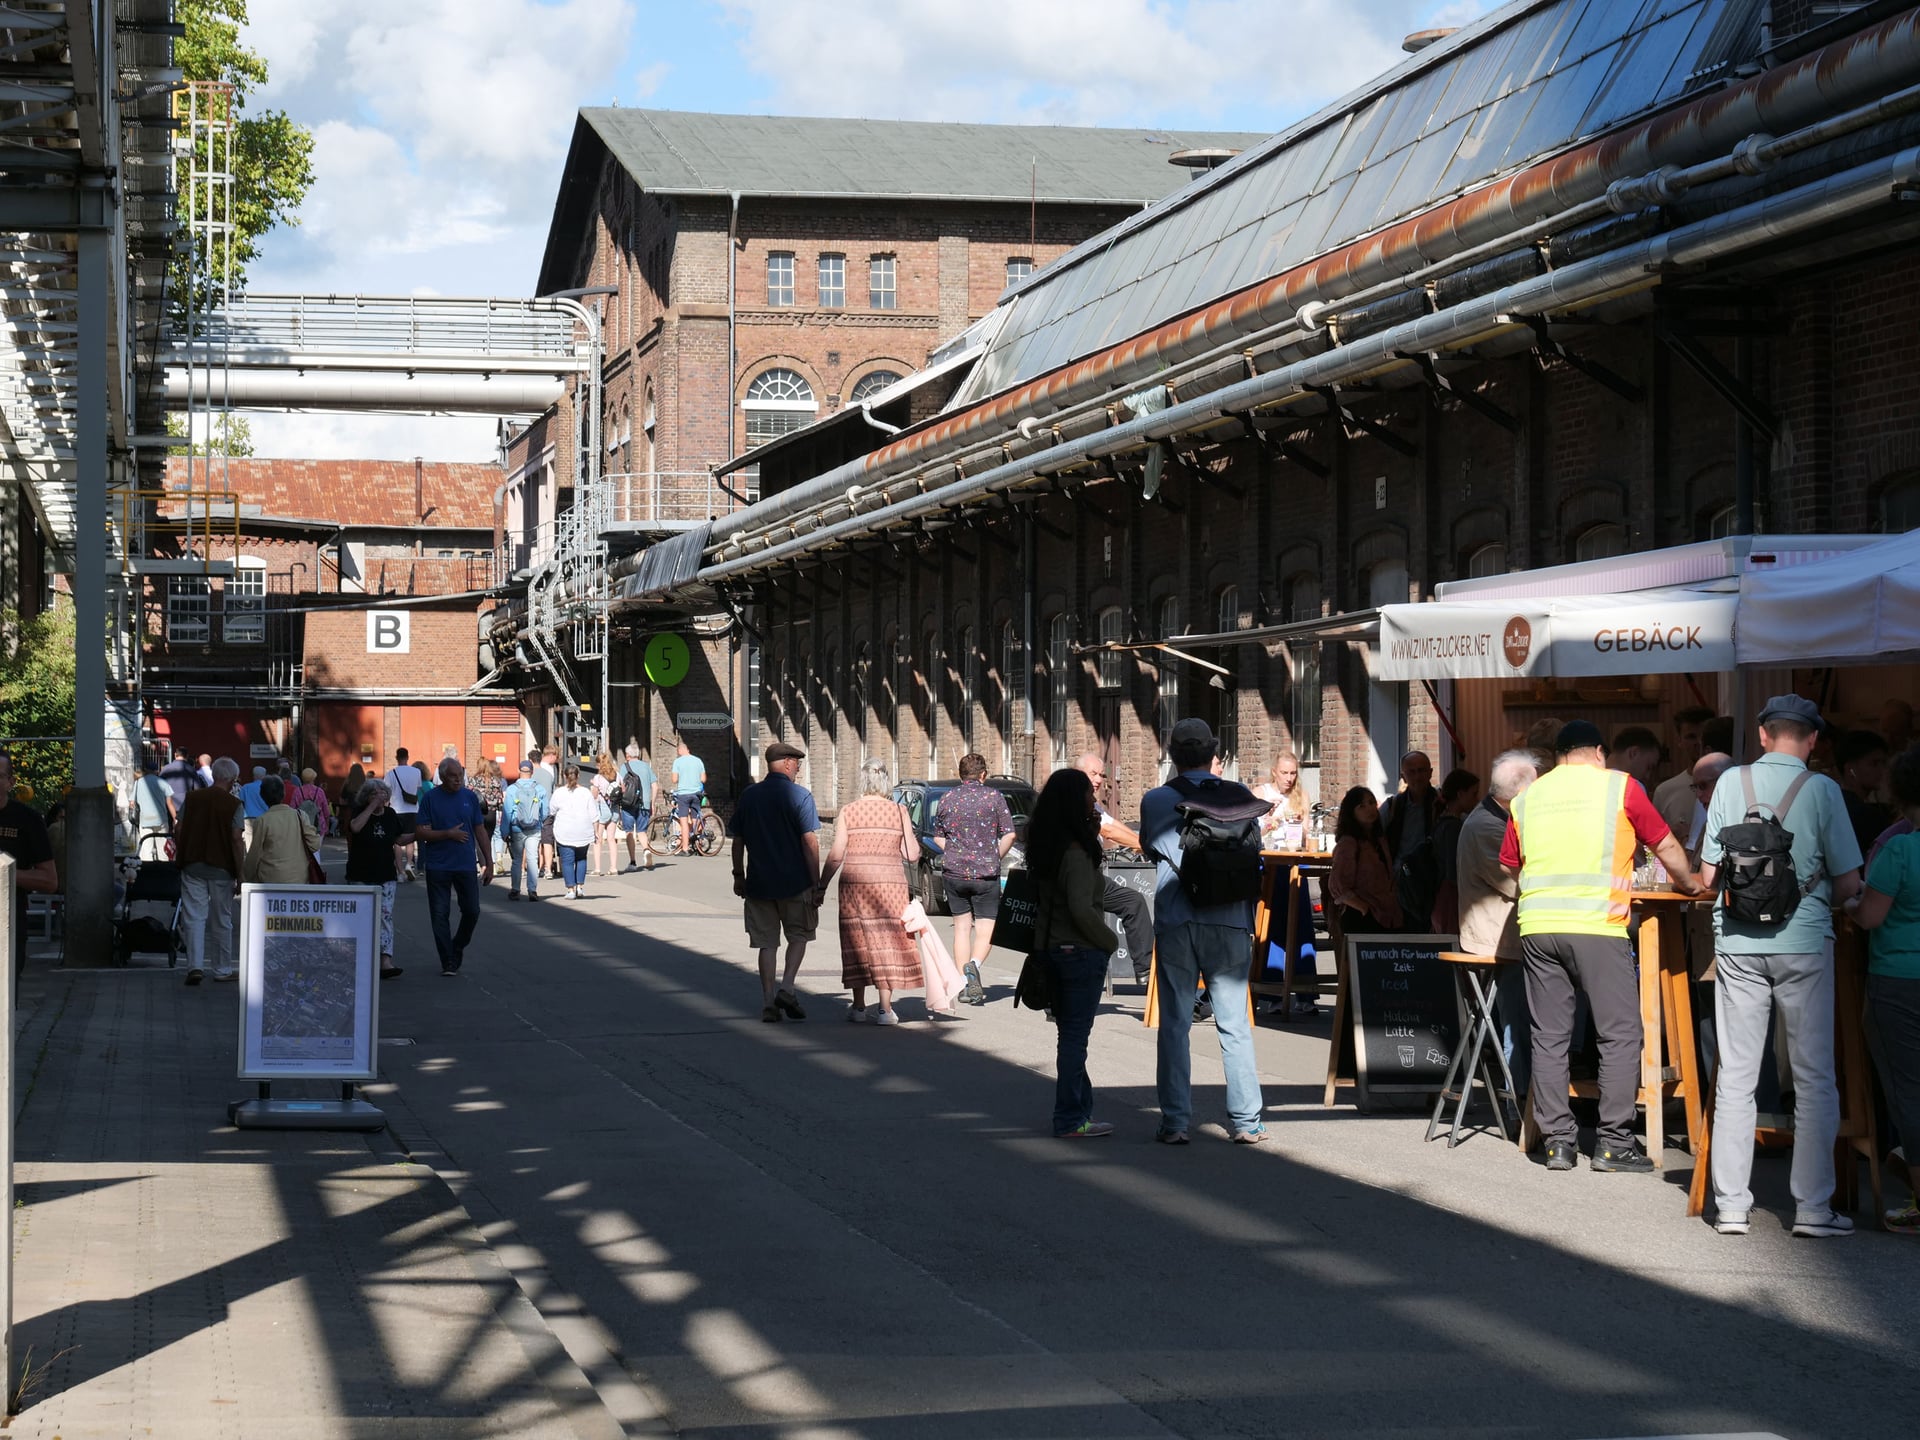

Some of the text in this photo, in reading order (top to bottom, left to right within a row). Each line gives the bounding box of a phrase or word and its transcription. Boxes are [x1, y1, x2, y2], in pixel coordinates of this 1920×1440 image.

[376, 616, 401, 649] B
[1593, 621, 1703, 654] GEBÄCK
[1390, 633, 1492, 661] WWW.ZIMT-ZUCKER.NET
[662, 648, 673, 671] 5
[678, 716, 728, 726] Verladerampe
[267, 899, 357, 914] TAG DES OFFENEN
[266, 916, 324, 932] DENKMALS
[1385, 1025, 1415, 1038] Latte
